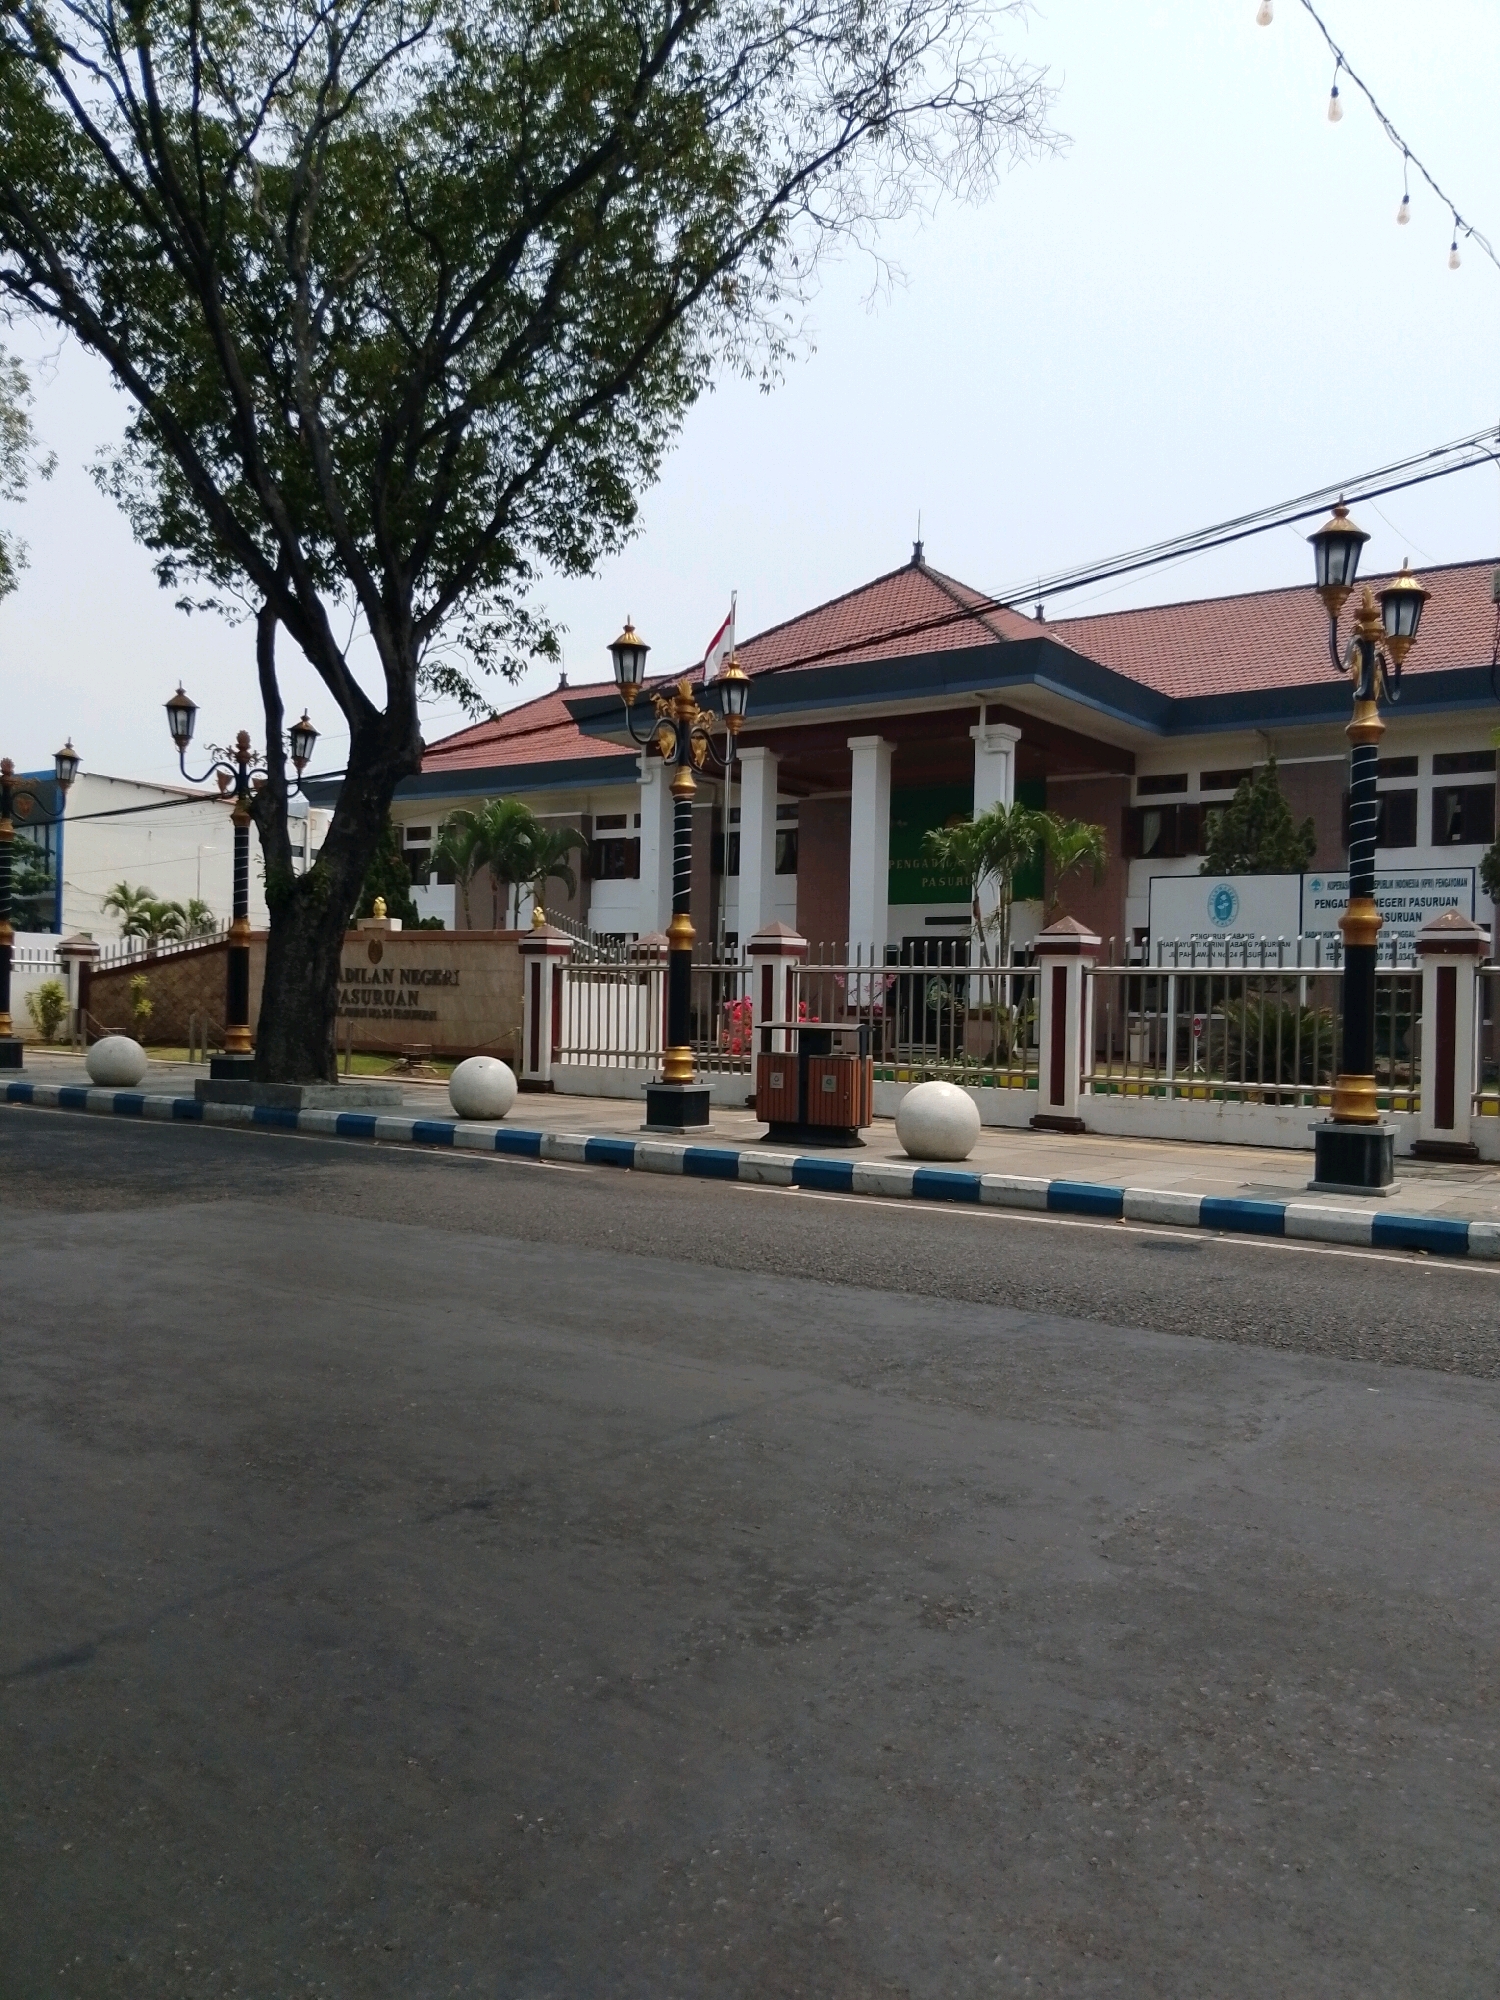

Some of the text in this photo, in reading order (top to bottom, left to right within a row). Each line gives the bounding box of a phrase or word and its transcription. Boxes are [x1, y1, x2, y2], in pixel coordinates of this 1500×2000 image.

[922, 877, 970, 887] PASURU
[1395, 879, 1419, 889] INDONESIA
[1435, 878, 1467, 888] PENGAYOMAN
[1315, 897, 1458, 909] PENGAD NEGERI PASURUAN
[1379, 912, 1422, 922] ASURUAN
[399, 968, 460, 986] NEGERI
[338, 988, 420, 1007] ASURUAN
